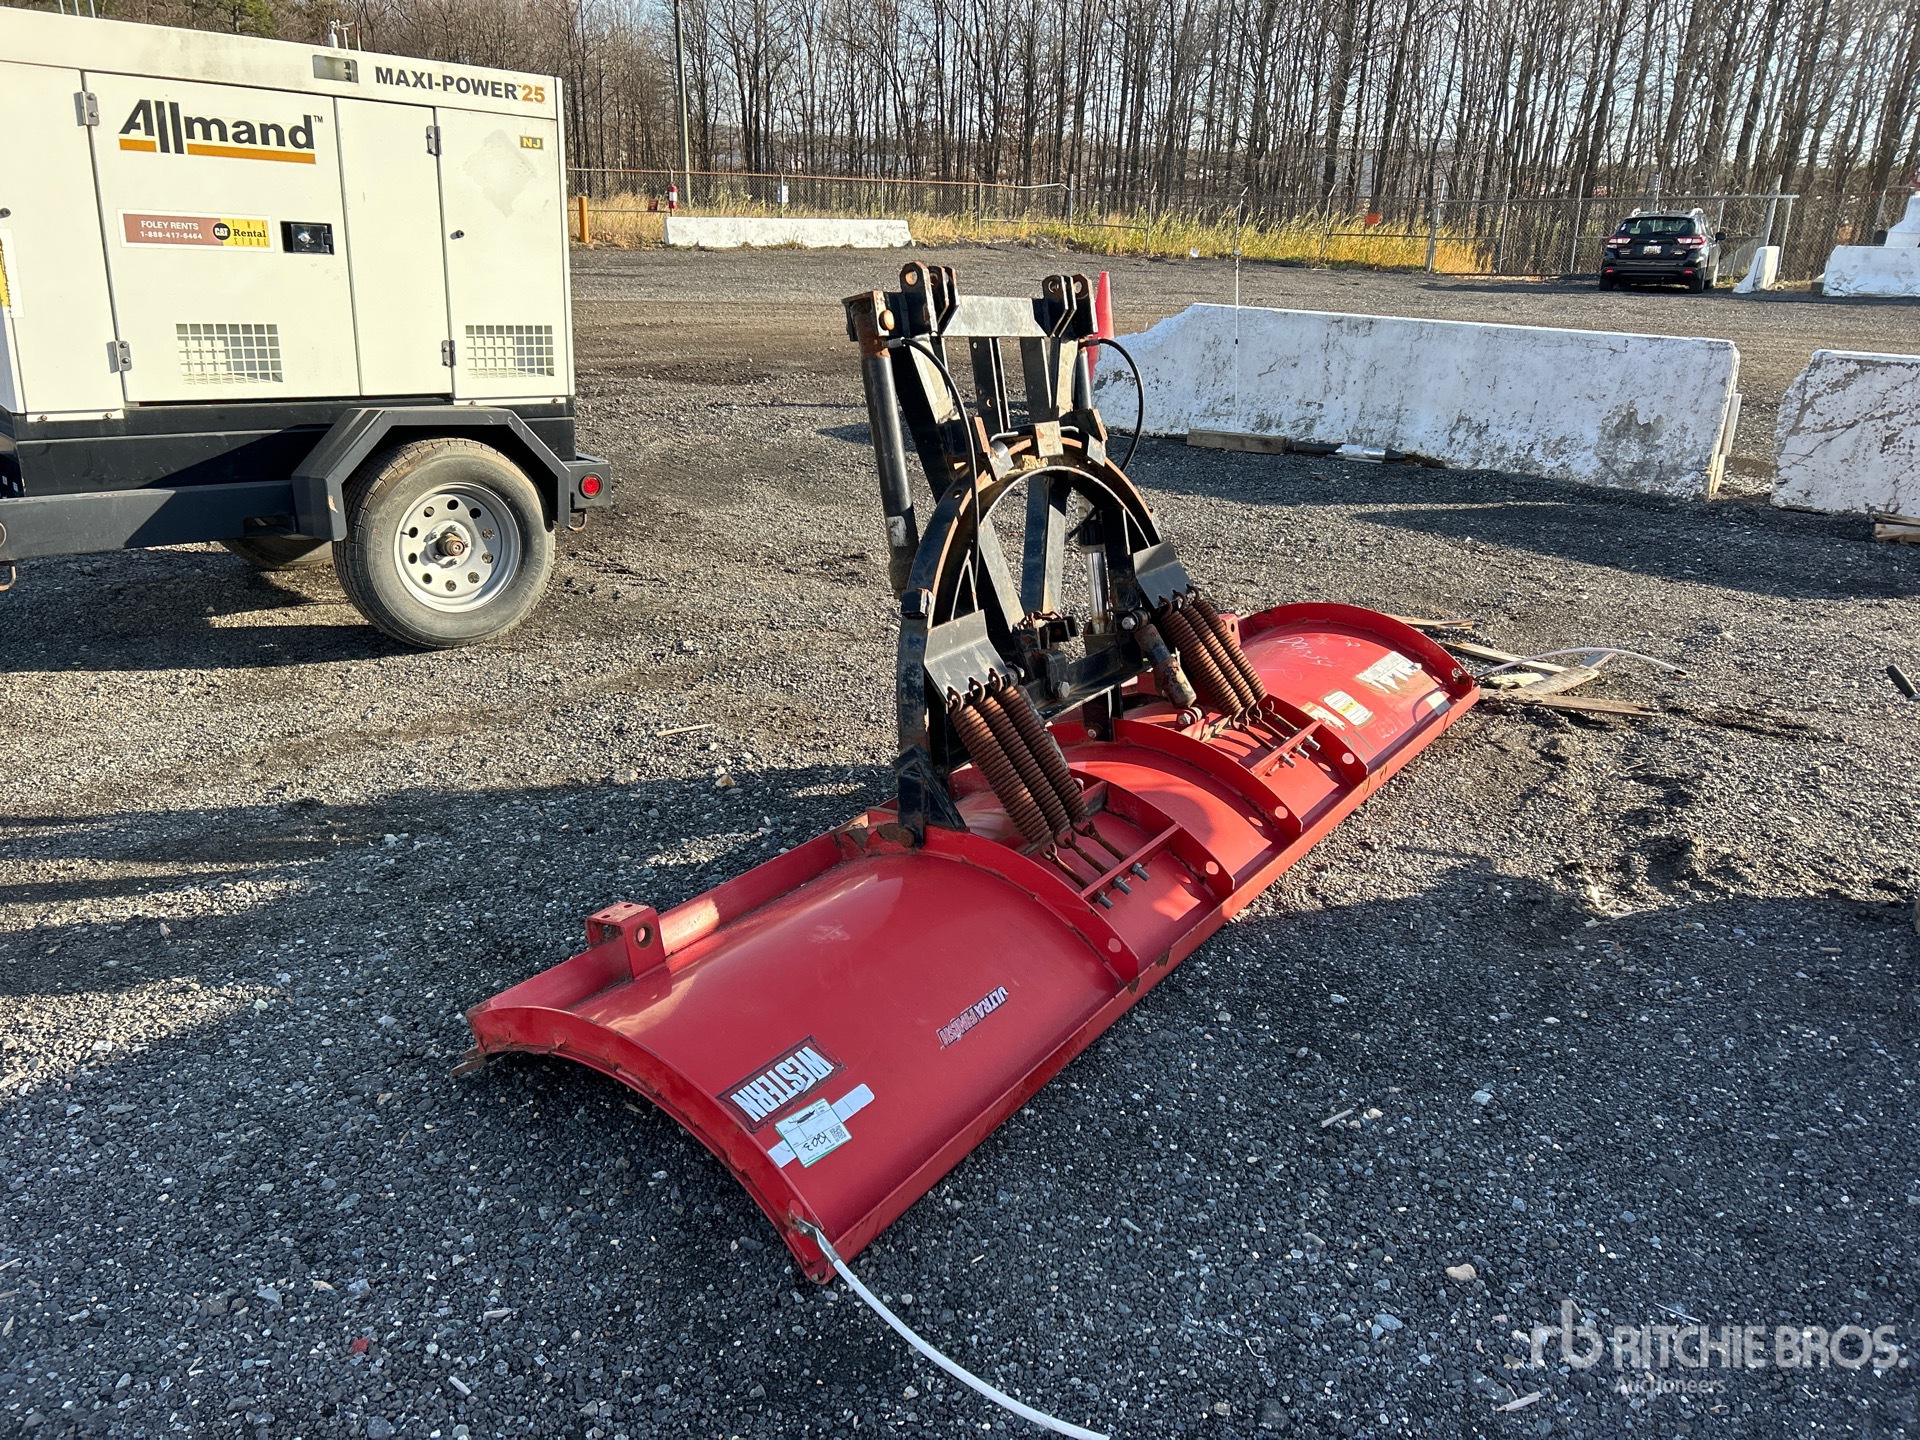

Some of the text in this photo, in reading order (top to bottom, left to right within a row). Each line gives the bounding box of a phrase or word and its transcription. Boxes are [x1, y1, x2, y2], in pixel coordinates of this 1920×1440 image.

[375, 66, 546, 104] MAXI-POWER 25
[118, 98, 316, 155] Allmand
[521, 136, 542, 149] NJ
[140, 220, 199, 231] FOLEY RENTS
[214, 227, 229, 237] CAT
[232, 228, 267, 239] Rental
[973, 986, 1010, 1020] ULTRA
[729, 1046, 835, 1123] WESTERN
